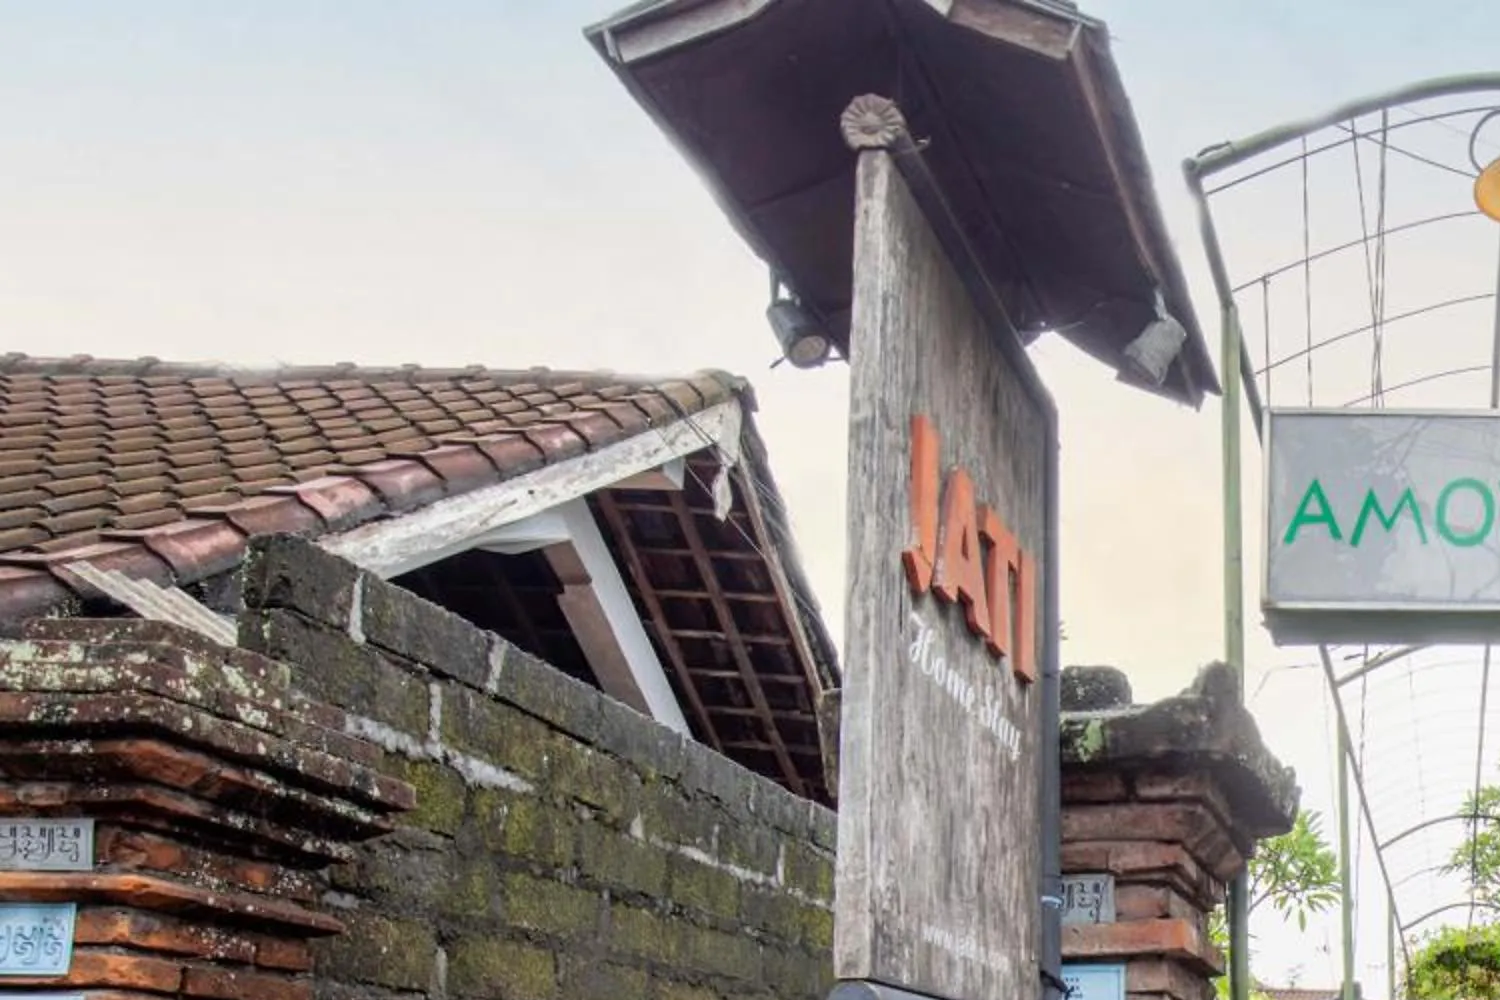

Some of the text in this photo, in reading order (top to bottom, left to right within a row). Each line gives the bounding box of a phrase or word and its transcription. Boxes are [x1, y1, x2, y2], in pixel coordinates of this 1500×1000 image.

[902, 414, 1036, 686] JATI
[908, 610, 1022, 761] Home Stay
